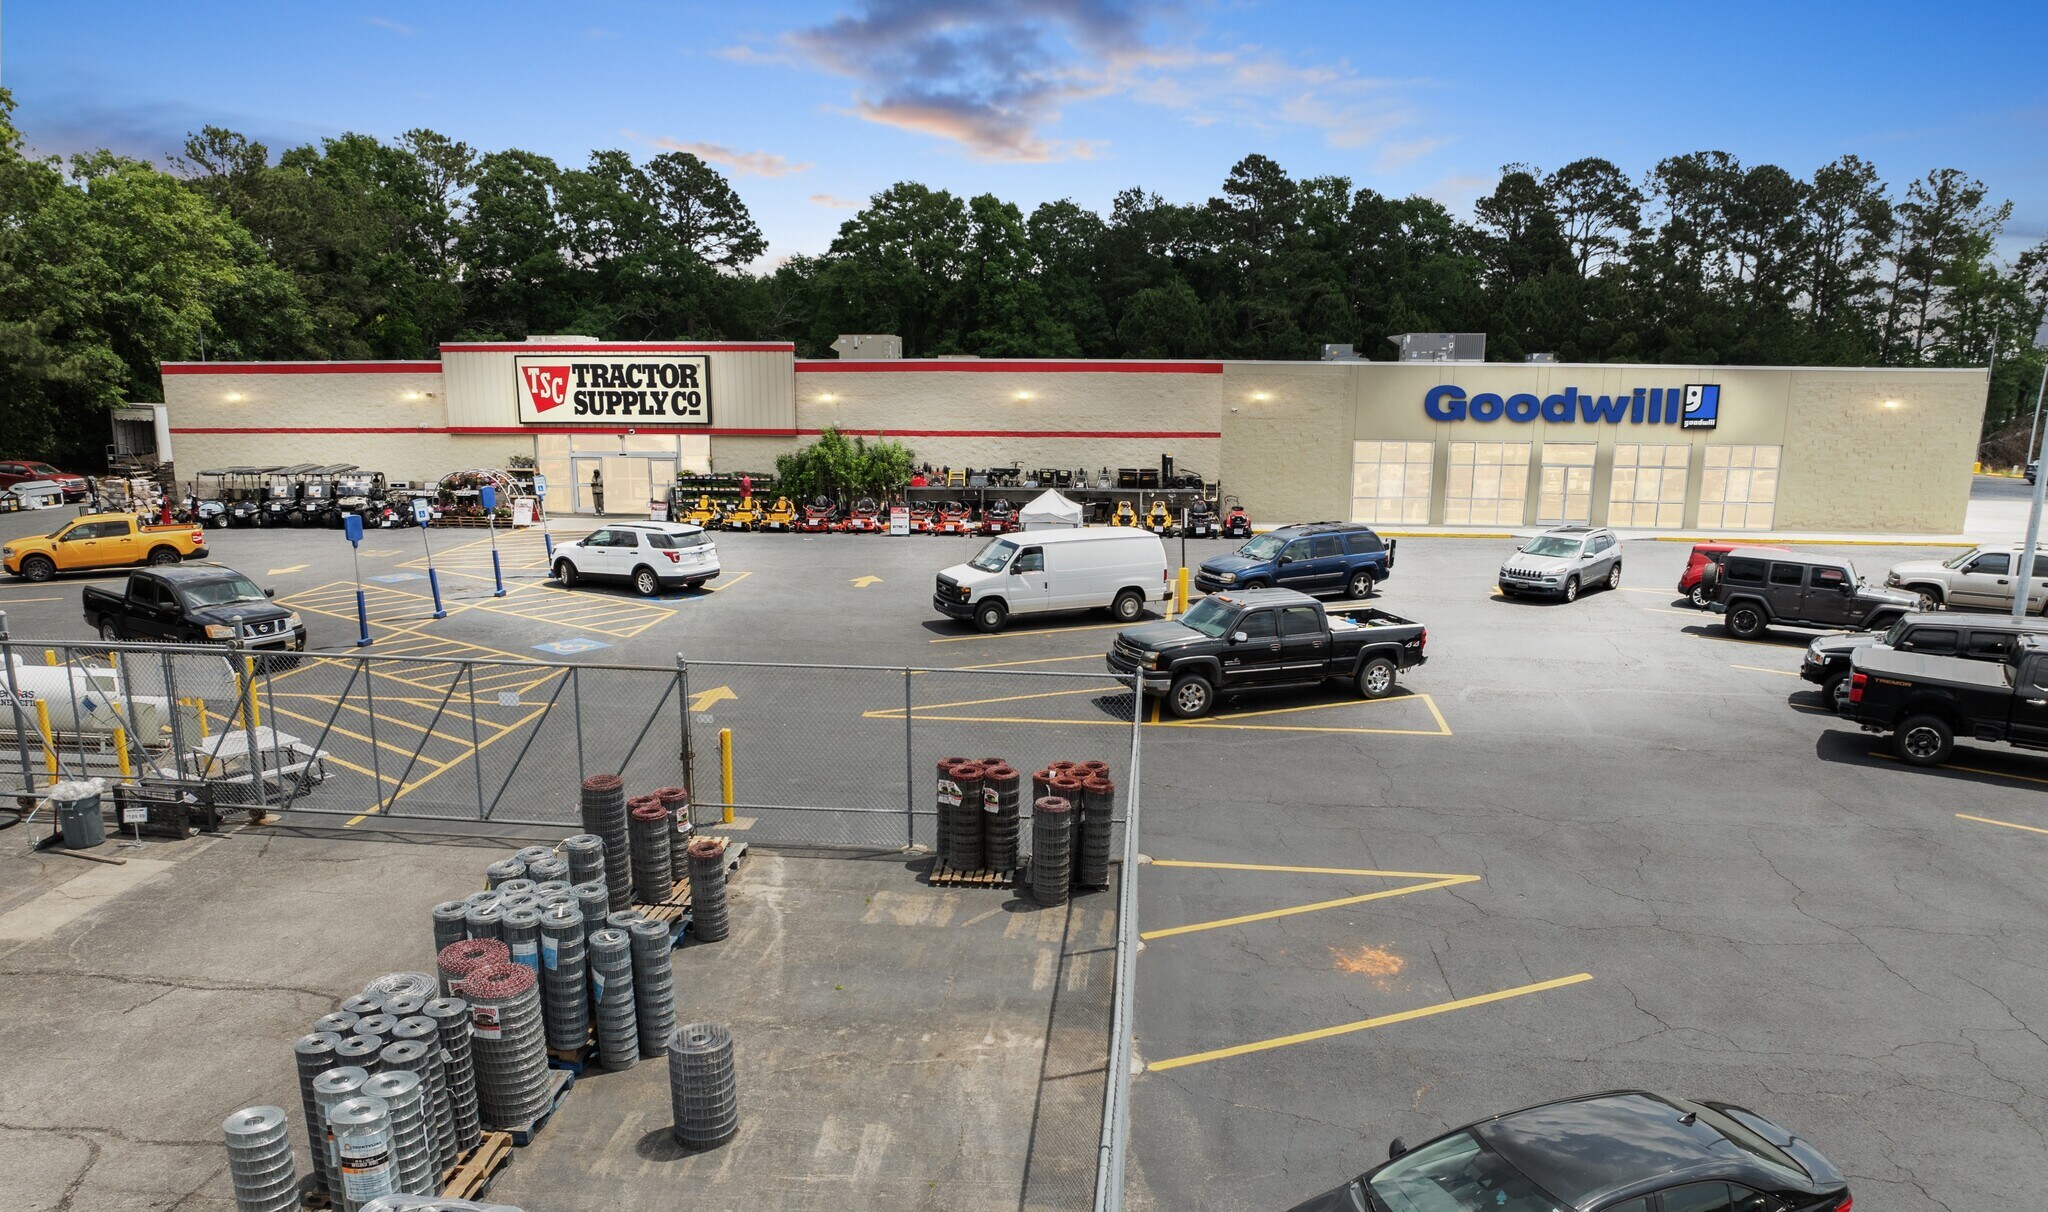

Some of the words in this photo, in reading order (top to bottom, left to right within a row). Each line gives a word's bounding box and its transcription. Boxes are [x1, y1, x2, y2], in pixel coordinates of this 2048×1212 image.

[527, 367, 563, 404] TSC
[571, 363, 699, 389] TRACTOR
[573, 390, 668, 416] SUPPLY
[1424, 384, 1680, 424] Goodwill
[1683, 418, 1716, 428] goodwill
[1873, 677, 1912, 687] TREMOR
